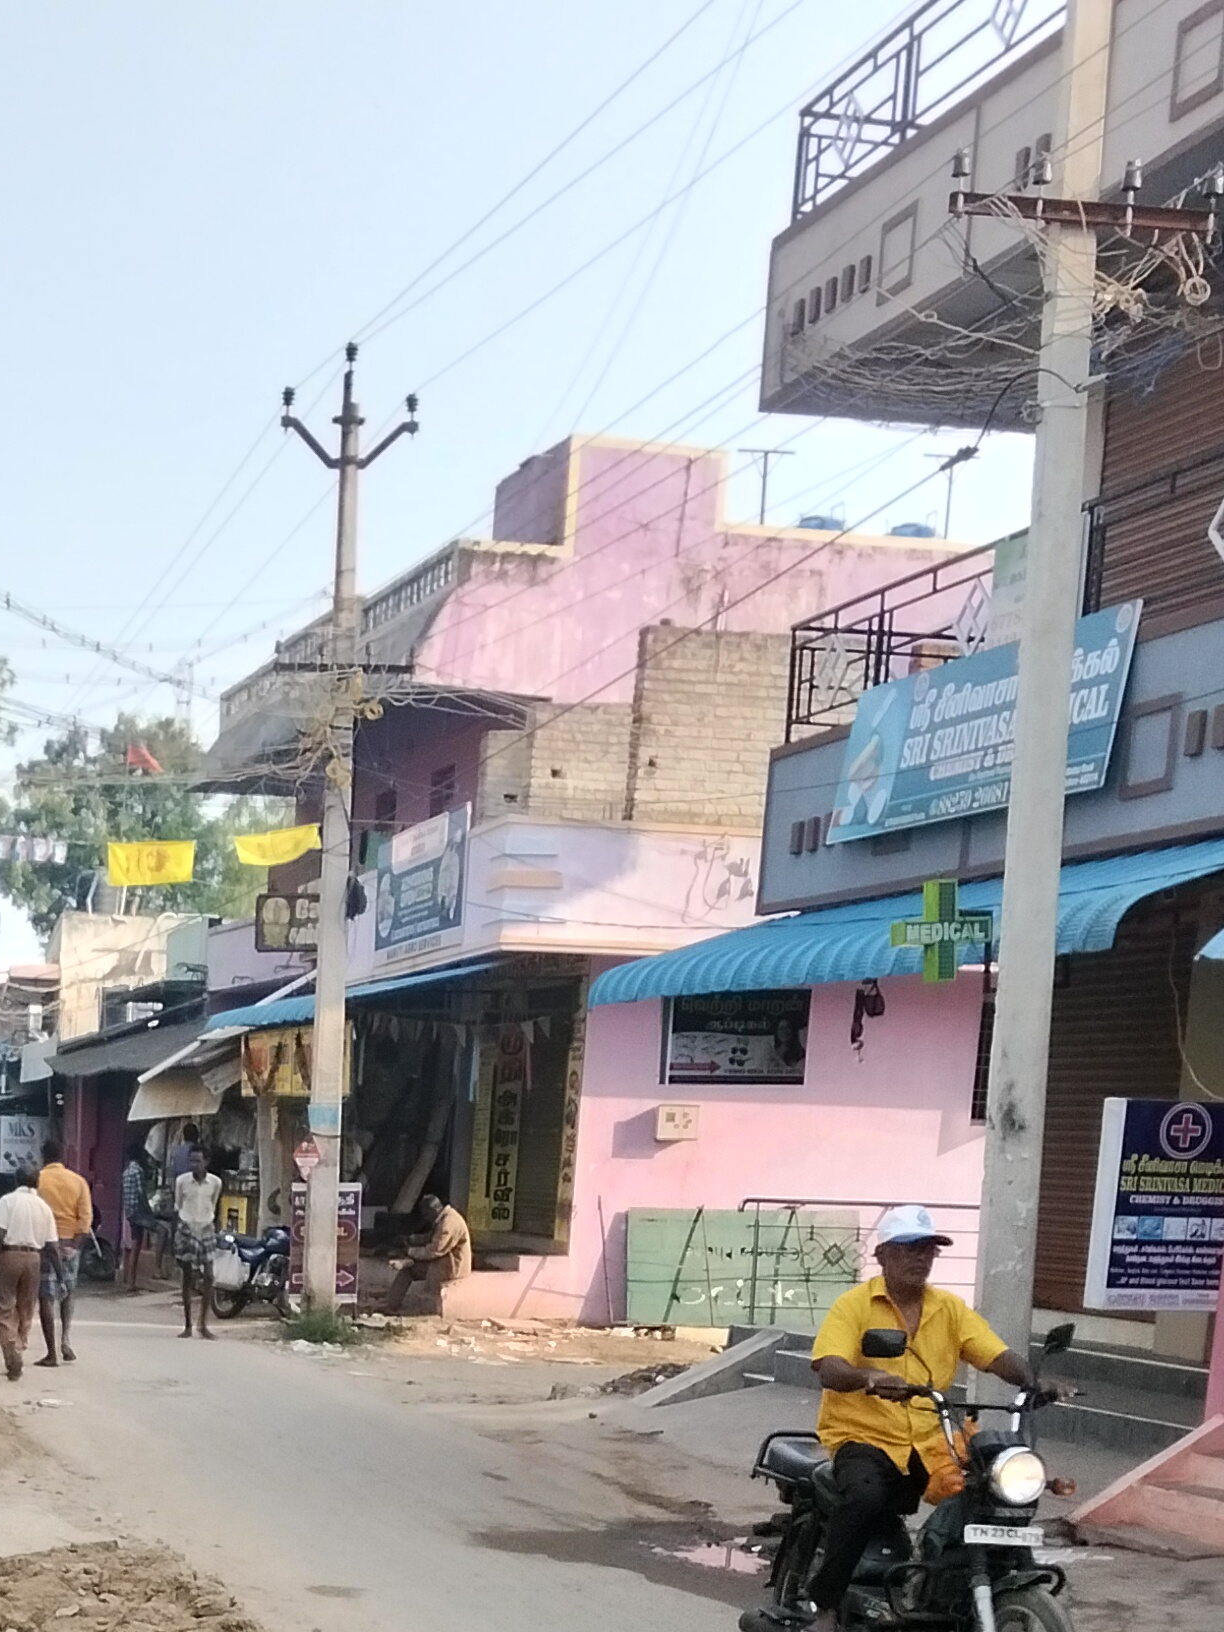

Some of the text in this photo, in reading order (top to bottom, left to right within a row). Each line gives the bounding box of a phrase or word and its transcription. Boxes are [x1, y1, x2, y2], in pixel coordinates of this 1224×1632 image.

[899, 733, 932, 769] SRI
[905, 921, 986, 943] MEDICAL
[7, 1121, 35, 1137] MKS
[1120, 1175, 1224, 1194] SRI SRINIVASA MEDIC
[1129, 1194, 1224, 1206] CHEMIST & DRUGGIS
[971, 1526, 989, 1537] TN
[991, 1527, 1005, 1538] 23
